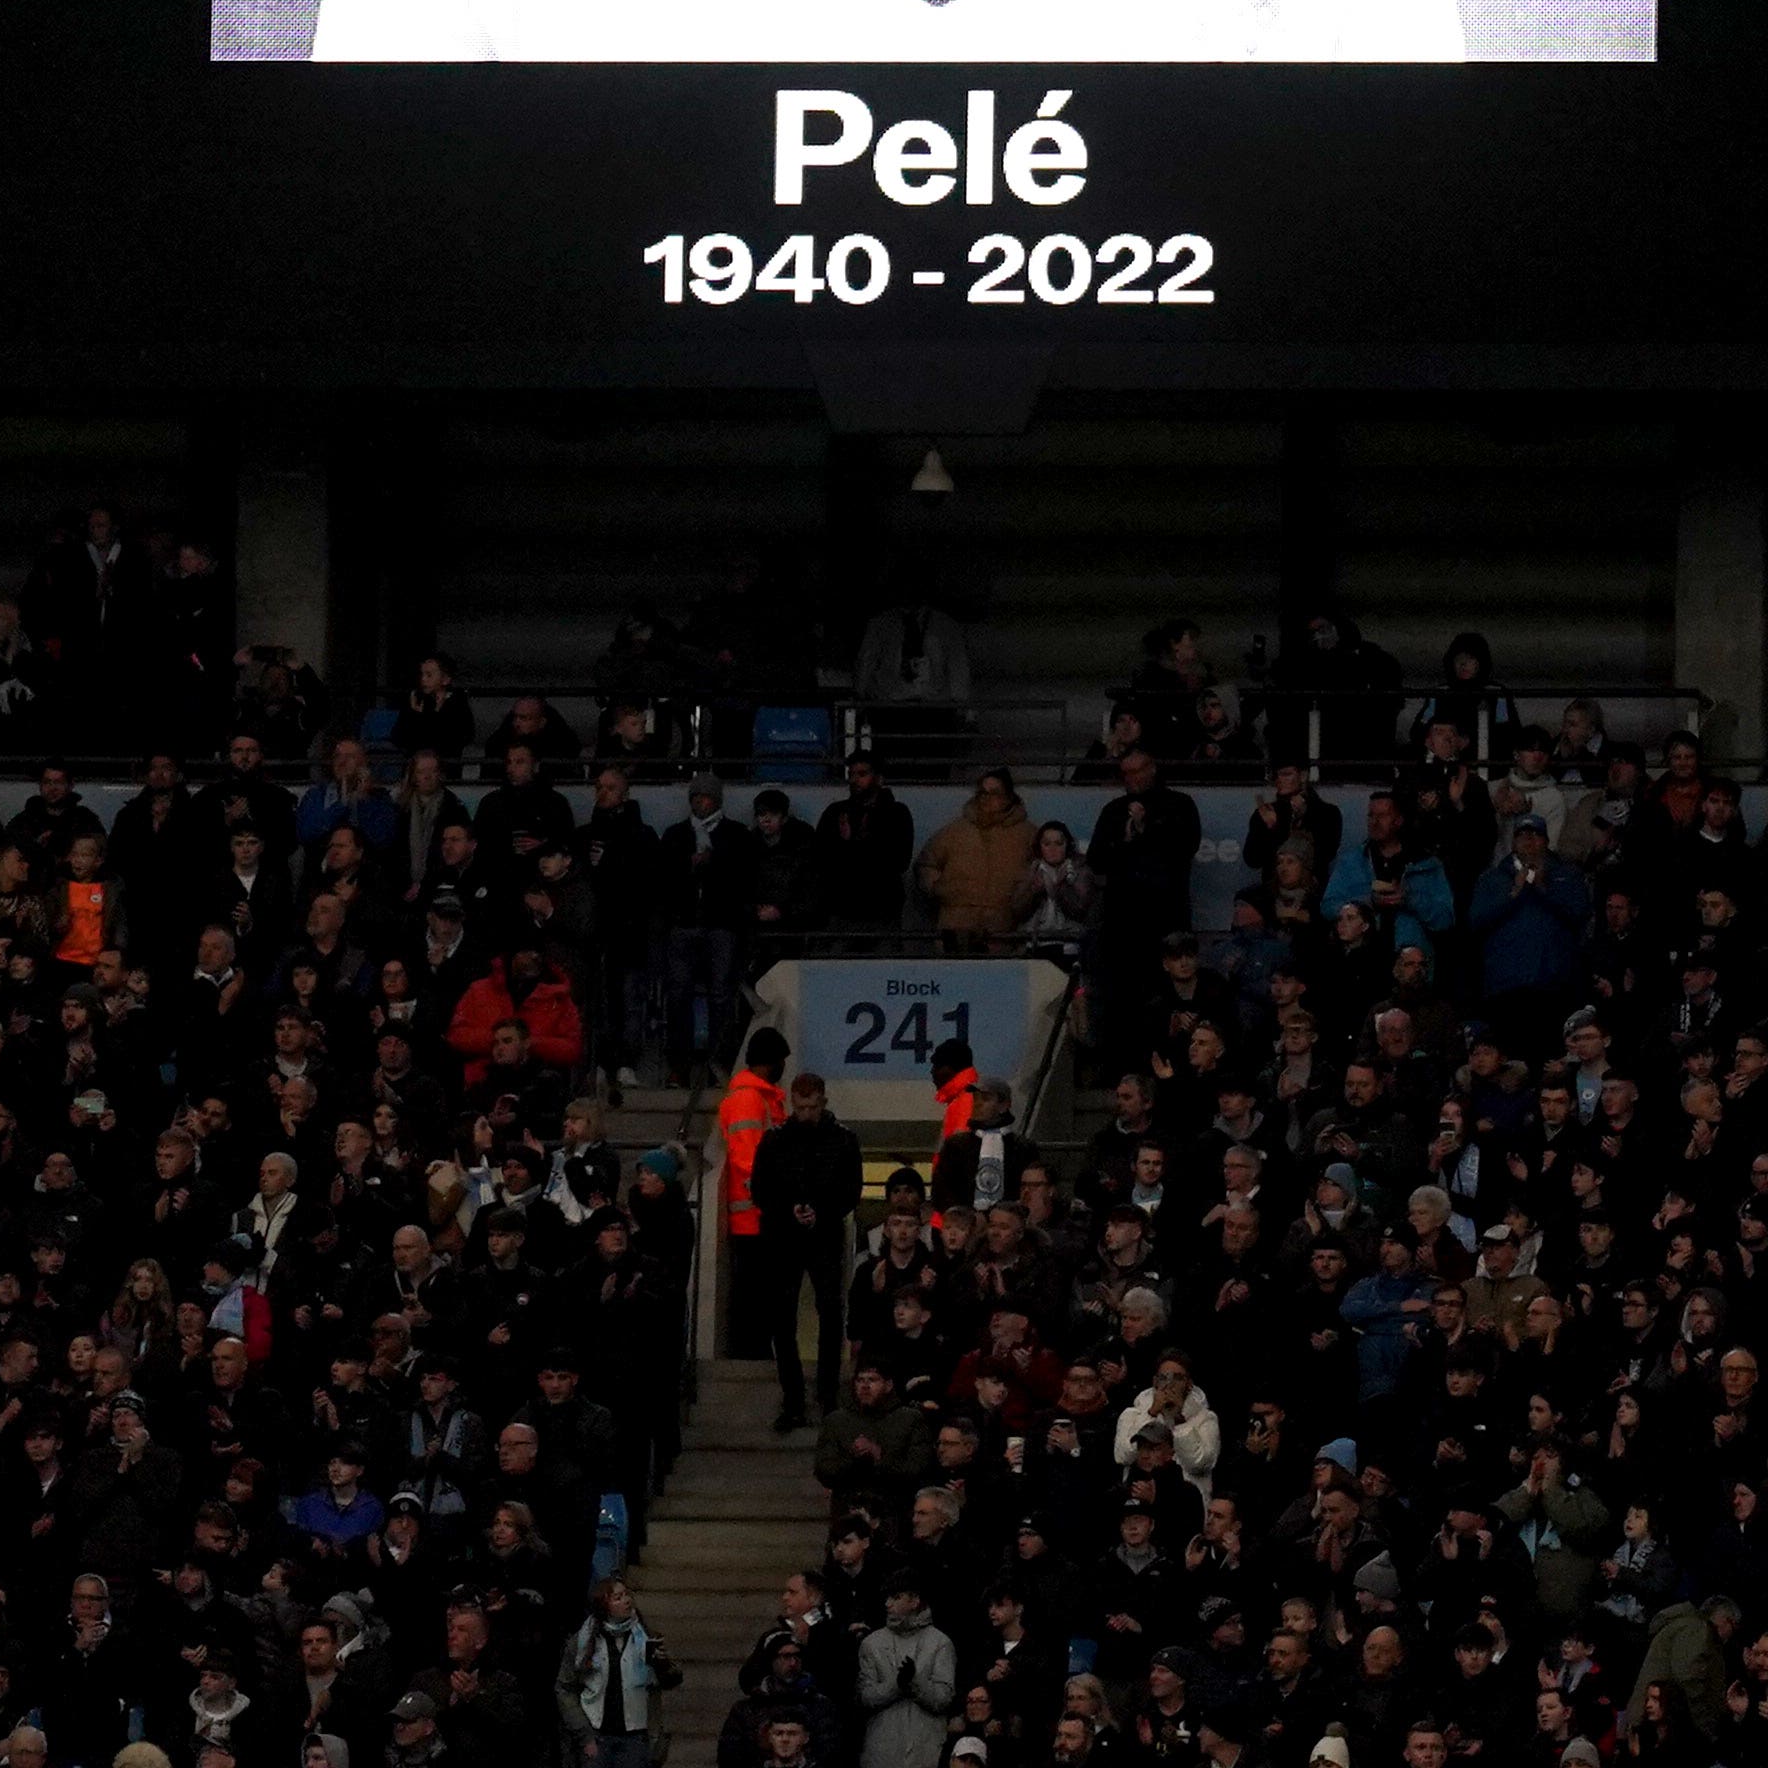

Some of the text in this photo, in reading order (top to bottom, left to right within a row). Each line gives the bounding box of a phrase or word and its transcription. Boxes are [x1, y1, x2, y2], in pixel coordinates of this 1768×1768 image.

[774, 90, 1087, 205] Pelé
[644, 233, 1214, 305] 1940 - 2022
[886, 979, 941, 996] Block
[844, 1001, 970, 1064] 241
